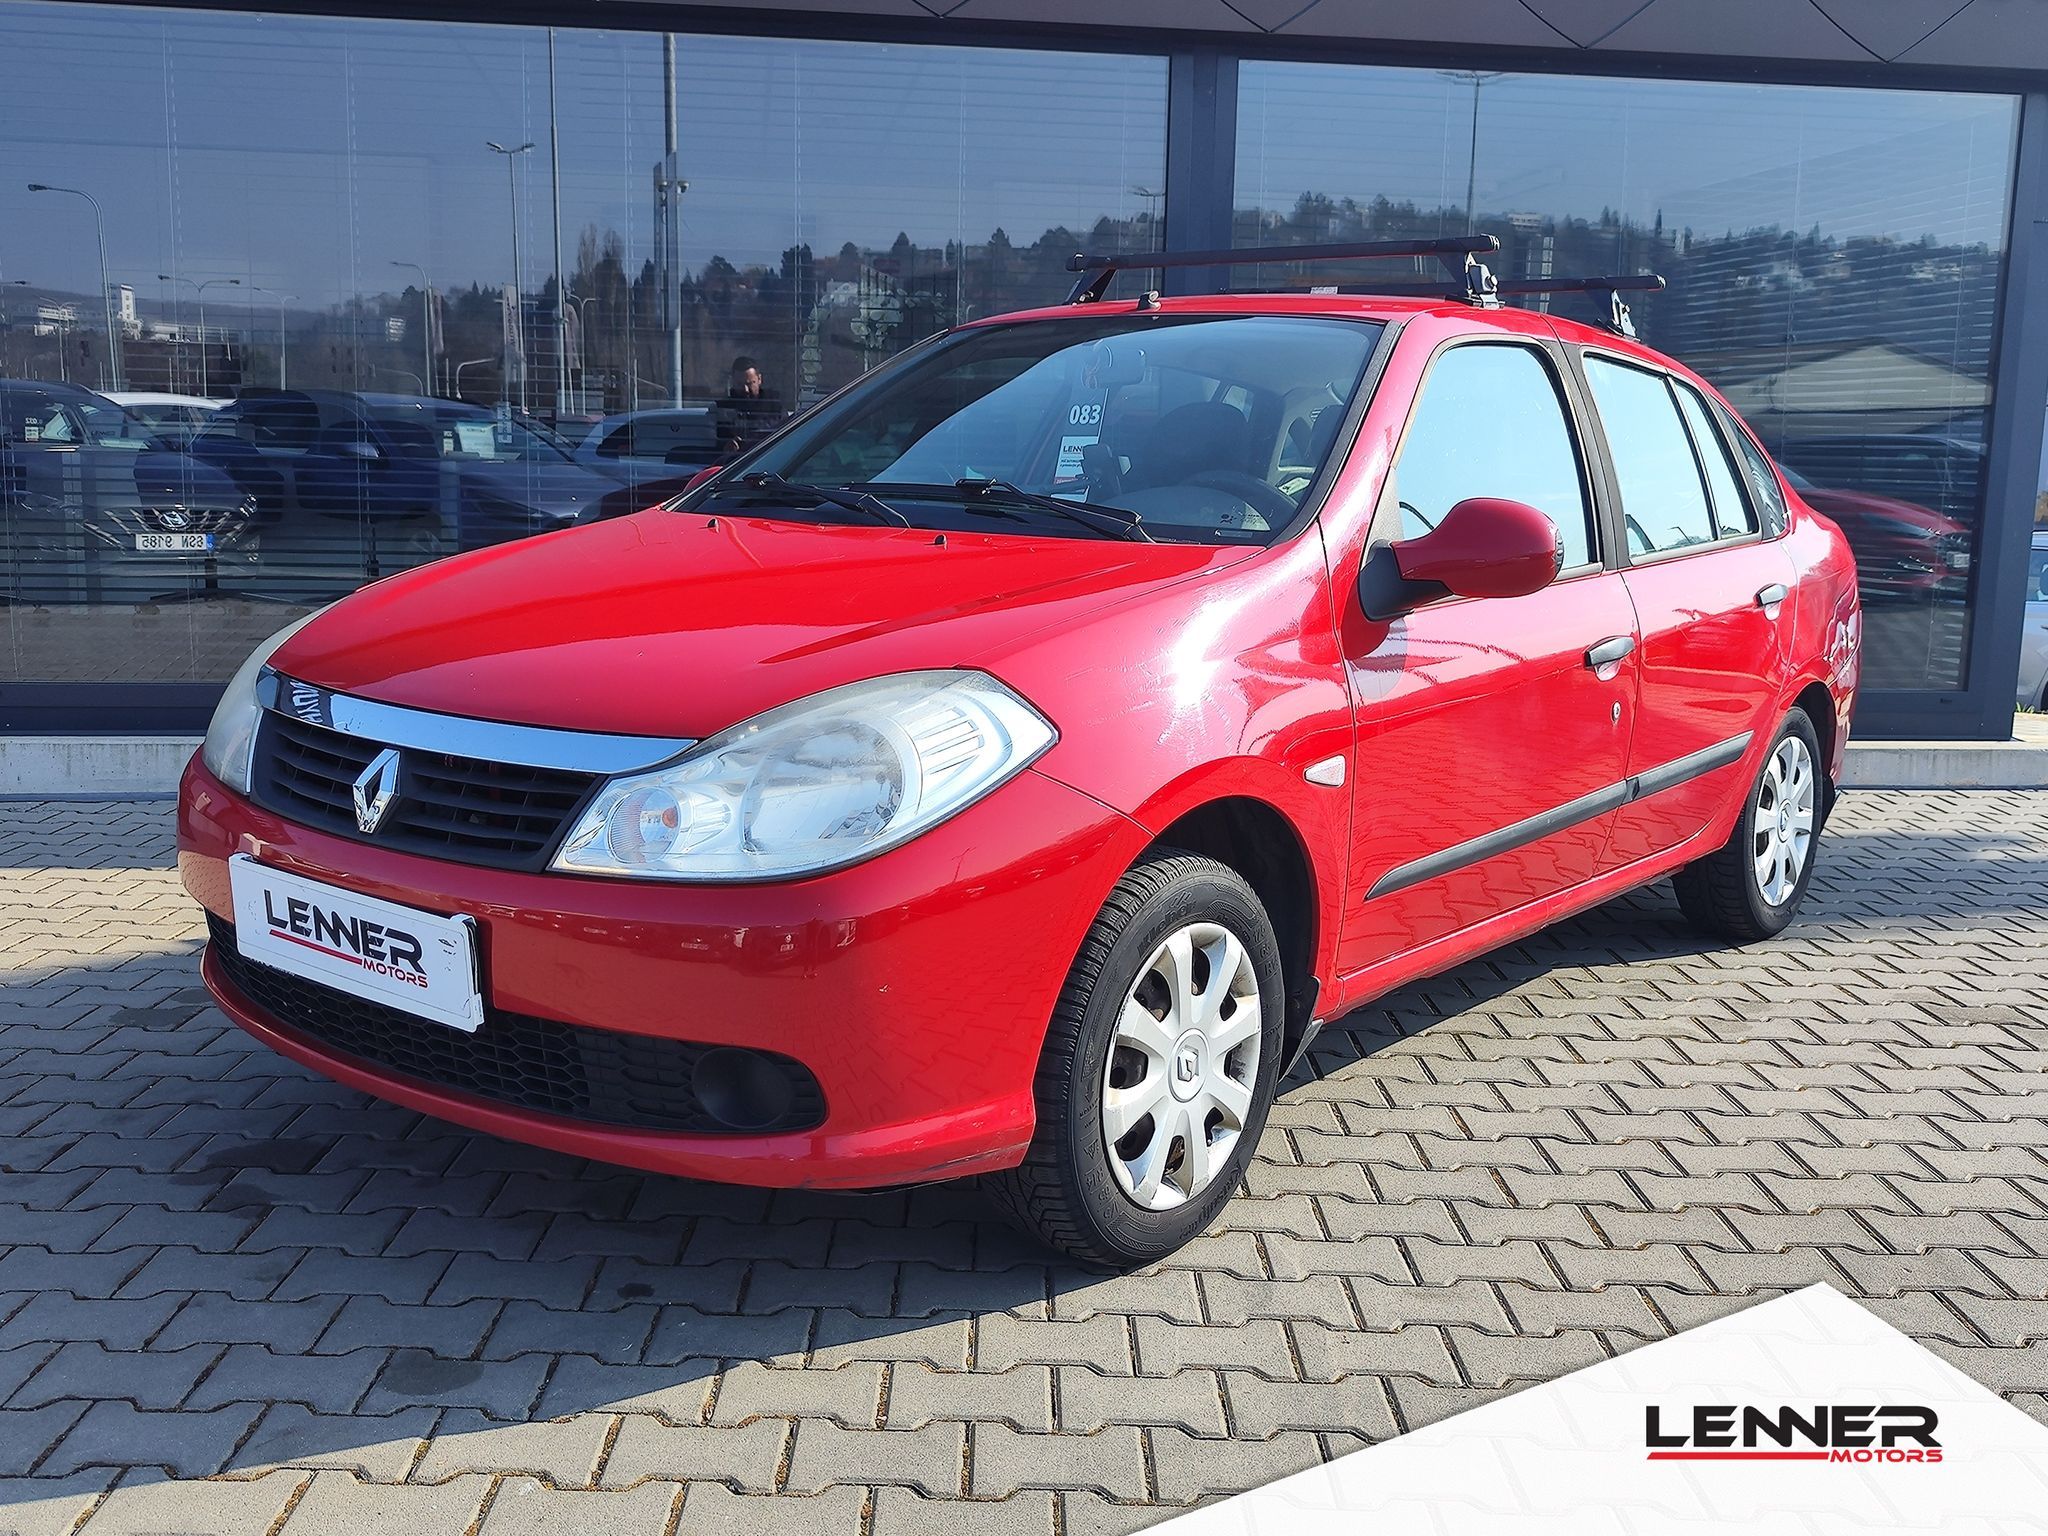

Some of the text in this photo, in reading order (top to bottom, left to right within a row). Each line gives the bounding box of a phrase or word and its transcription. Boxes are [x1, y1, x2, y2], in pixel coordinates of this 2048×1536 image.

[1069, 404, 1101, 425] 083
[1063, 445, 1083, 453] LENN
[264, 889, 428, 976] LENNER
[363, 959, 429, 989] MOTORS
